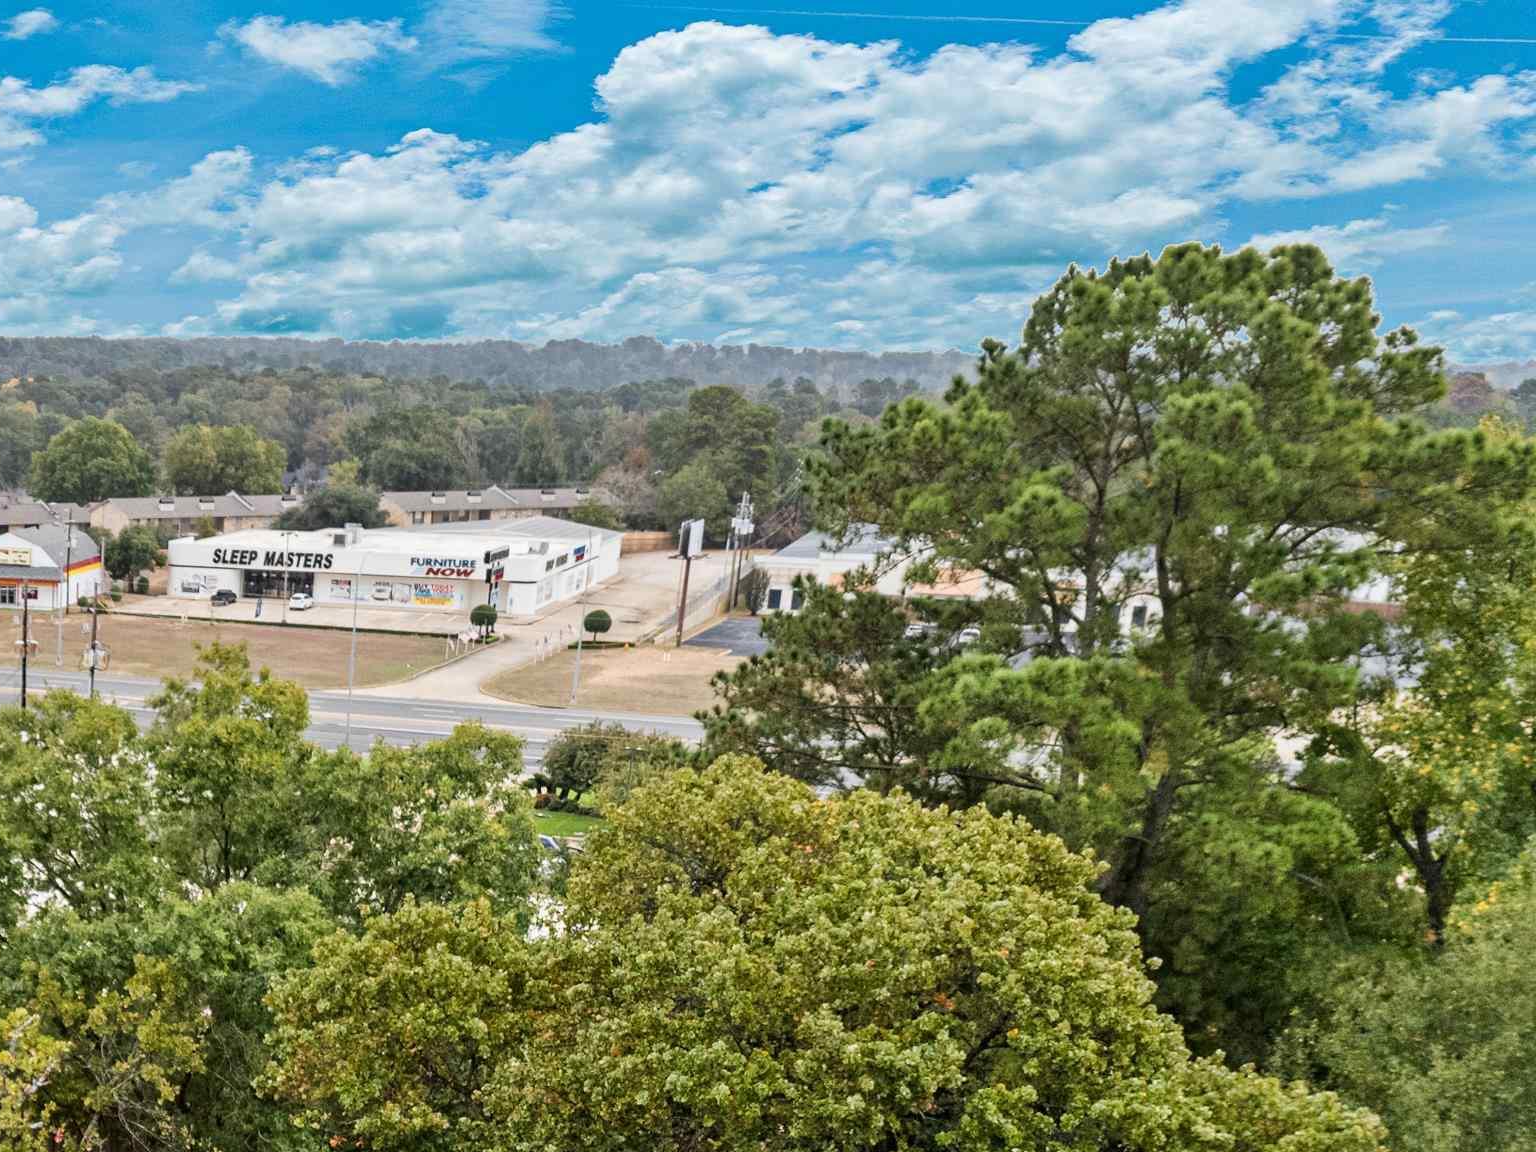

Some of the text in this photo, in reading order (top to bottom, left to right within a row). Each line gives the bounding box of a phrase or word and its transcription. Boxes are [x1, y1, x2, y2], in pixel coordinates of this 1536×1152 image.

[212, 547, 334, 570] SLEEP MASTERS
[410, 556, 476, 569] FURNITURE
[425, 567, 476, 578] NOW
